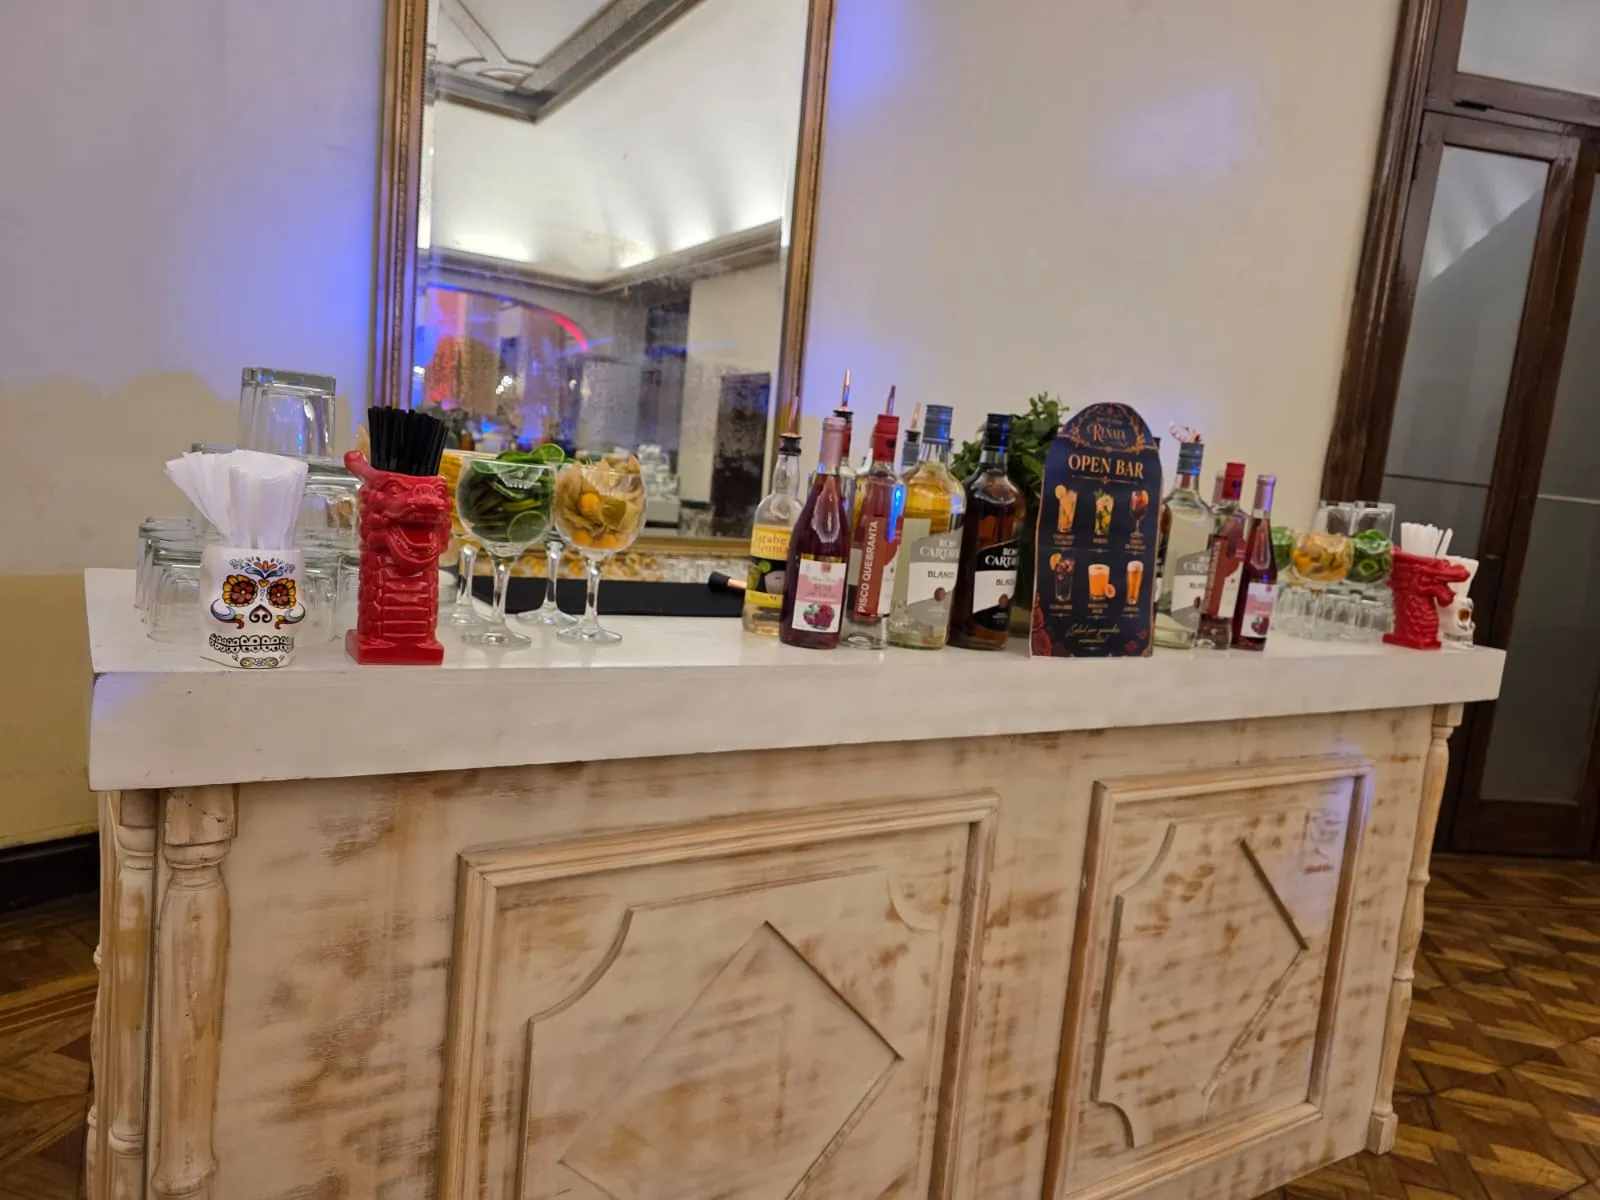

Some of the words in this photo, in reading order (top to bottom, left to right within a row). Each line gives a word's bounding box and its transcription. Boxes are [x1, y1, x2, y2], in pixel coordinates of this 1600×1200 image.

[1068, 454, 1112, 475] OPEN
[1115, 460, 1144, 480] BAR
[862, 520, 879, 582] QUEBRANTA
[857, 583, 870, 613] PISCO
